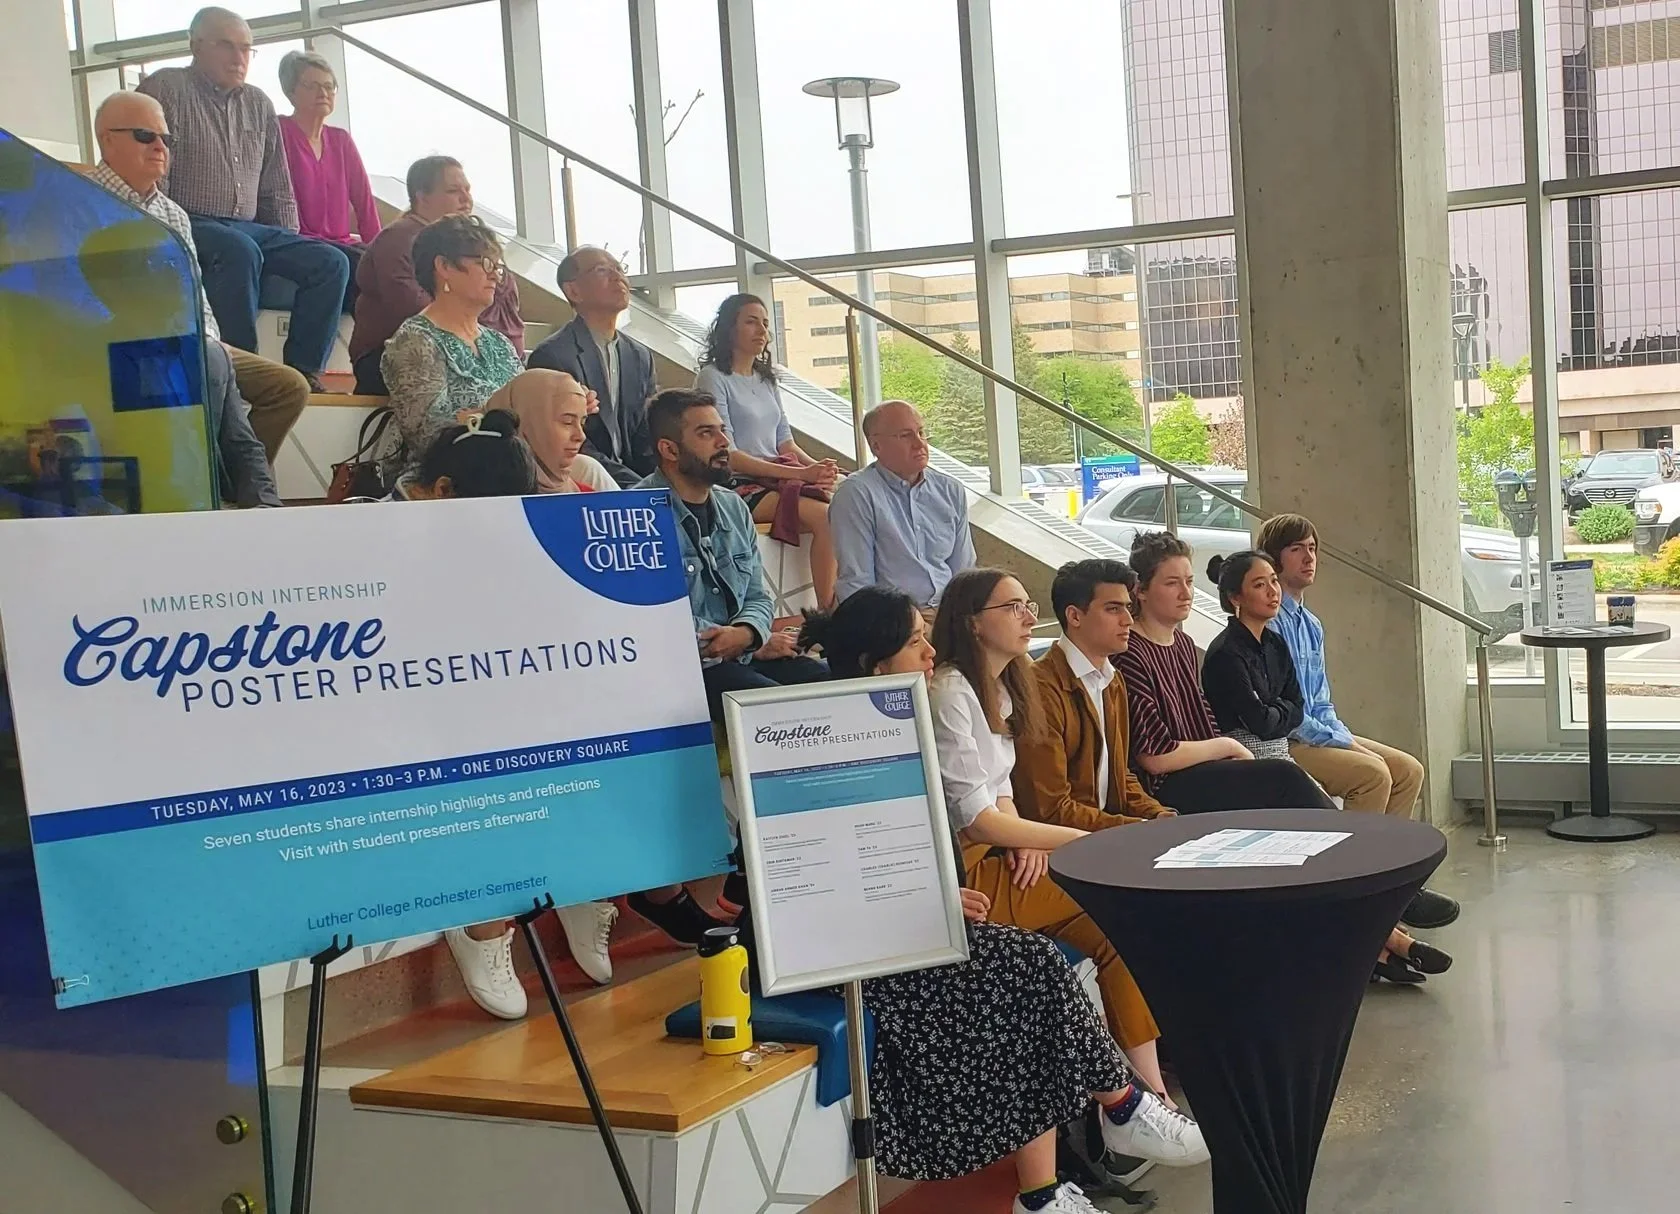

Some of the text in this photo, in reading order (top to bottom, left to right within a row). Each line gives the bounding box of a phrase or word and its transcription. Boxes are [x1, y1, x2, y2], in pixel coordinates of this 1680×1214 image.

[1092, 466, 1126, 474] Consultant
[582, 507, 661, 540] LUTHER
[584, 541, 667, 573] COLLEGE
[142, 581, 388, 614] IMMERSION INTERNSHIP
[63, 610, 386, 698] Capstone
[181, 636, 637, 713] POSTER PRESENTATIONS
[884, 691, 909, 703] LUTHER
[884, 700, 911, 712] COLLEGE
[755, 723, 832, 747] Capstone
[780, 727, 902, 751] POSTER PRESENTATIONS
[150, 797, 233, 820] TUESDAY,
[238, 790, 273, 807] MAY
[280, 787, 304, 801] 16,
[308, 780, 347, 798] 2023
[418, 766, 448, 781] P.M.
[462, 759, 492, 775] ONE
[495, 747, 573, 770] DISCOVERY
[577, 739, 630, 758] SQUARE
[203, 778, 601, 850] Seven students share internship highlights and reflections
[279, 806, 550, 862] Visit with student presenters afterward!
[307, 875, 548, 930] Luther College Rochester Semester
